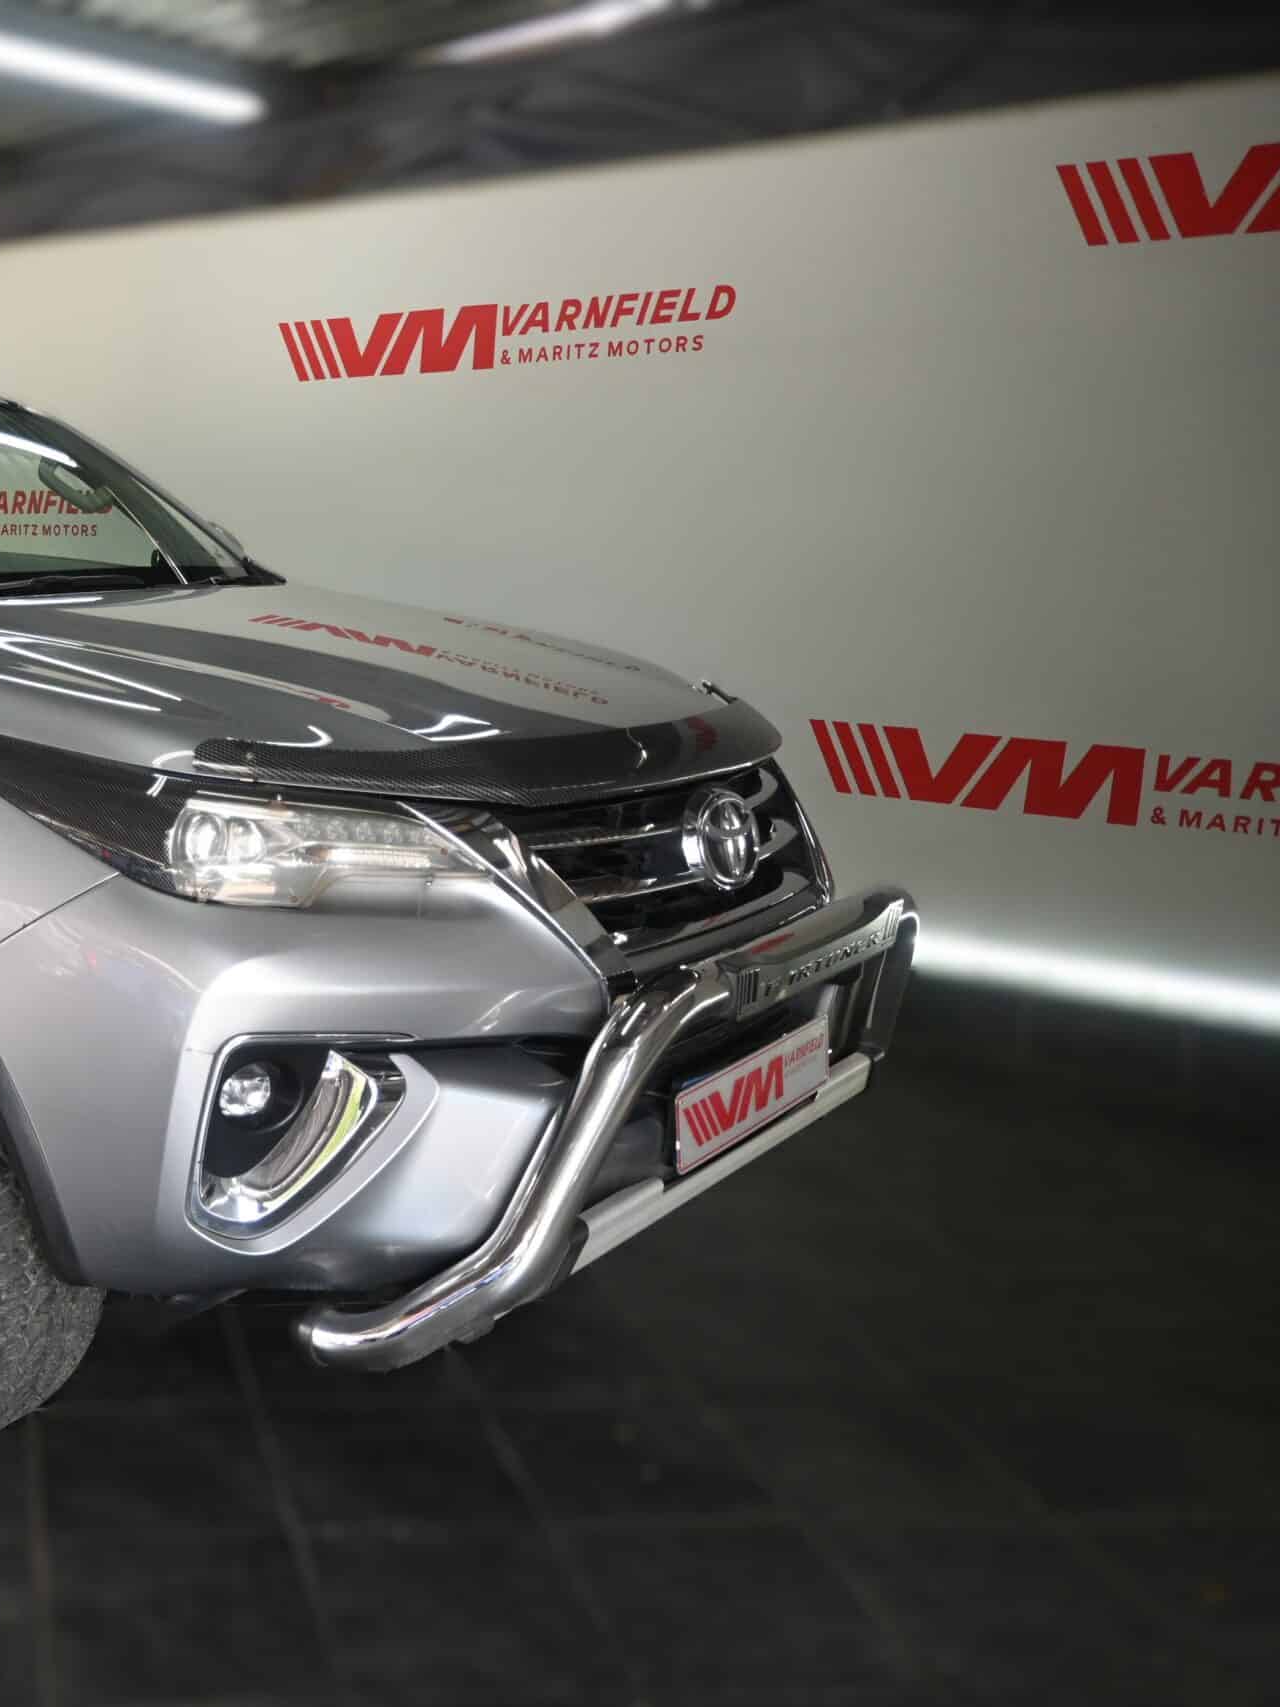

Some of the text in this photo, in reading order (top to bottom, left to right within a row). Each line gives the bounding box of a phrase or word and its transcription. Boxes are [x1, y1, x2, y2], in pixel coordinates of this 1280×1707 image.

[501, 285, 737, 337] VARNFIELD
[327, 304, 498, 377] VM
[500, 335, 705, 365] & MARITZ MOTORS
[42, 524, 97, 537] MOTORS
[882, 726, 1146, 826] VM
[1150, 806, 1167, 825] &
[708, 1055, 784, 1132] VM
